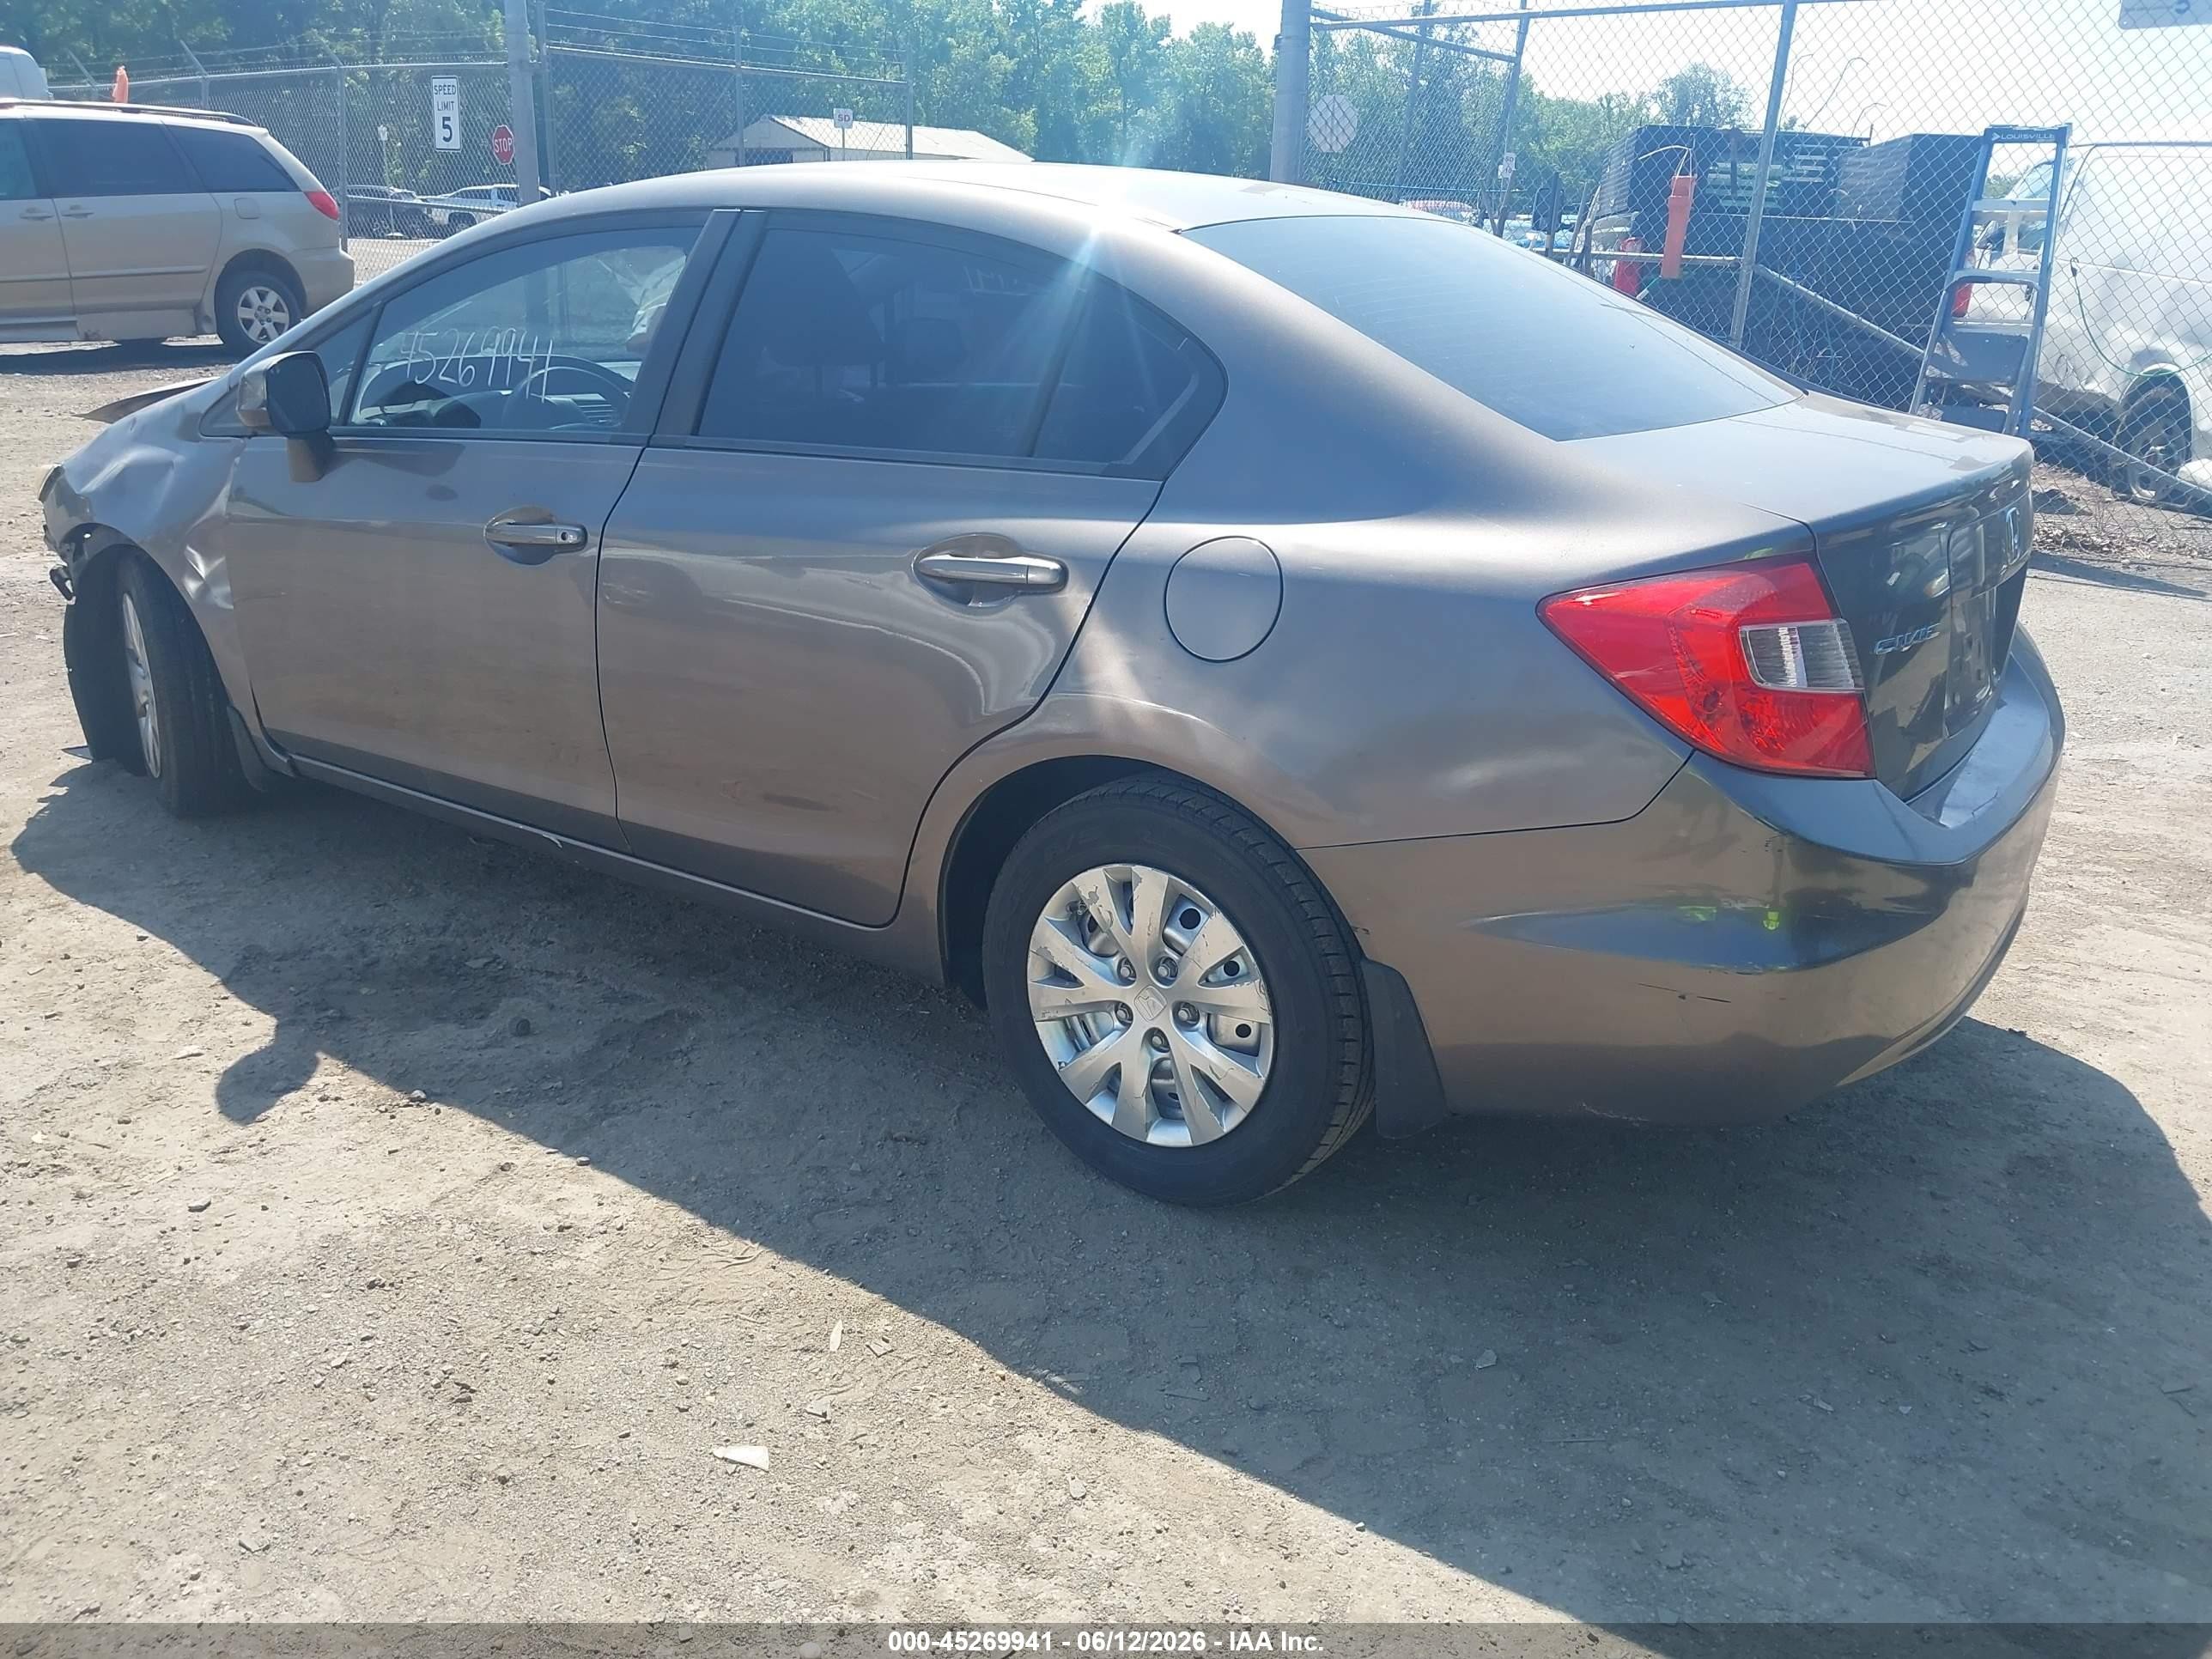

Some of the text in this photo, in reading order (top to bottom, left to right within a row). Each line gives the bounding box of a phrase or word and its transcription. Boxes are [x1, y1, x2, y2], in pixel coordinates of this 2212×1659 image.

[434, 84, 457, 95] SPEED
[436, 100, 454, 112] LIMIT
[837, 113, 851, 122] SD
[441, 116, 453, 143] 5
[494, 137, 513, 153] STOP
[400, 325, 553, 404] 45269941
[1875, 623, 1942, 654] CIVIC
